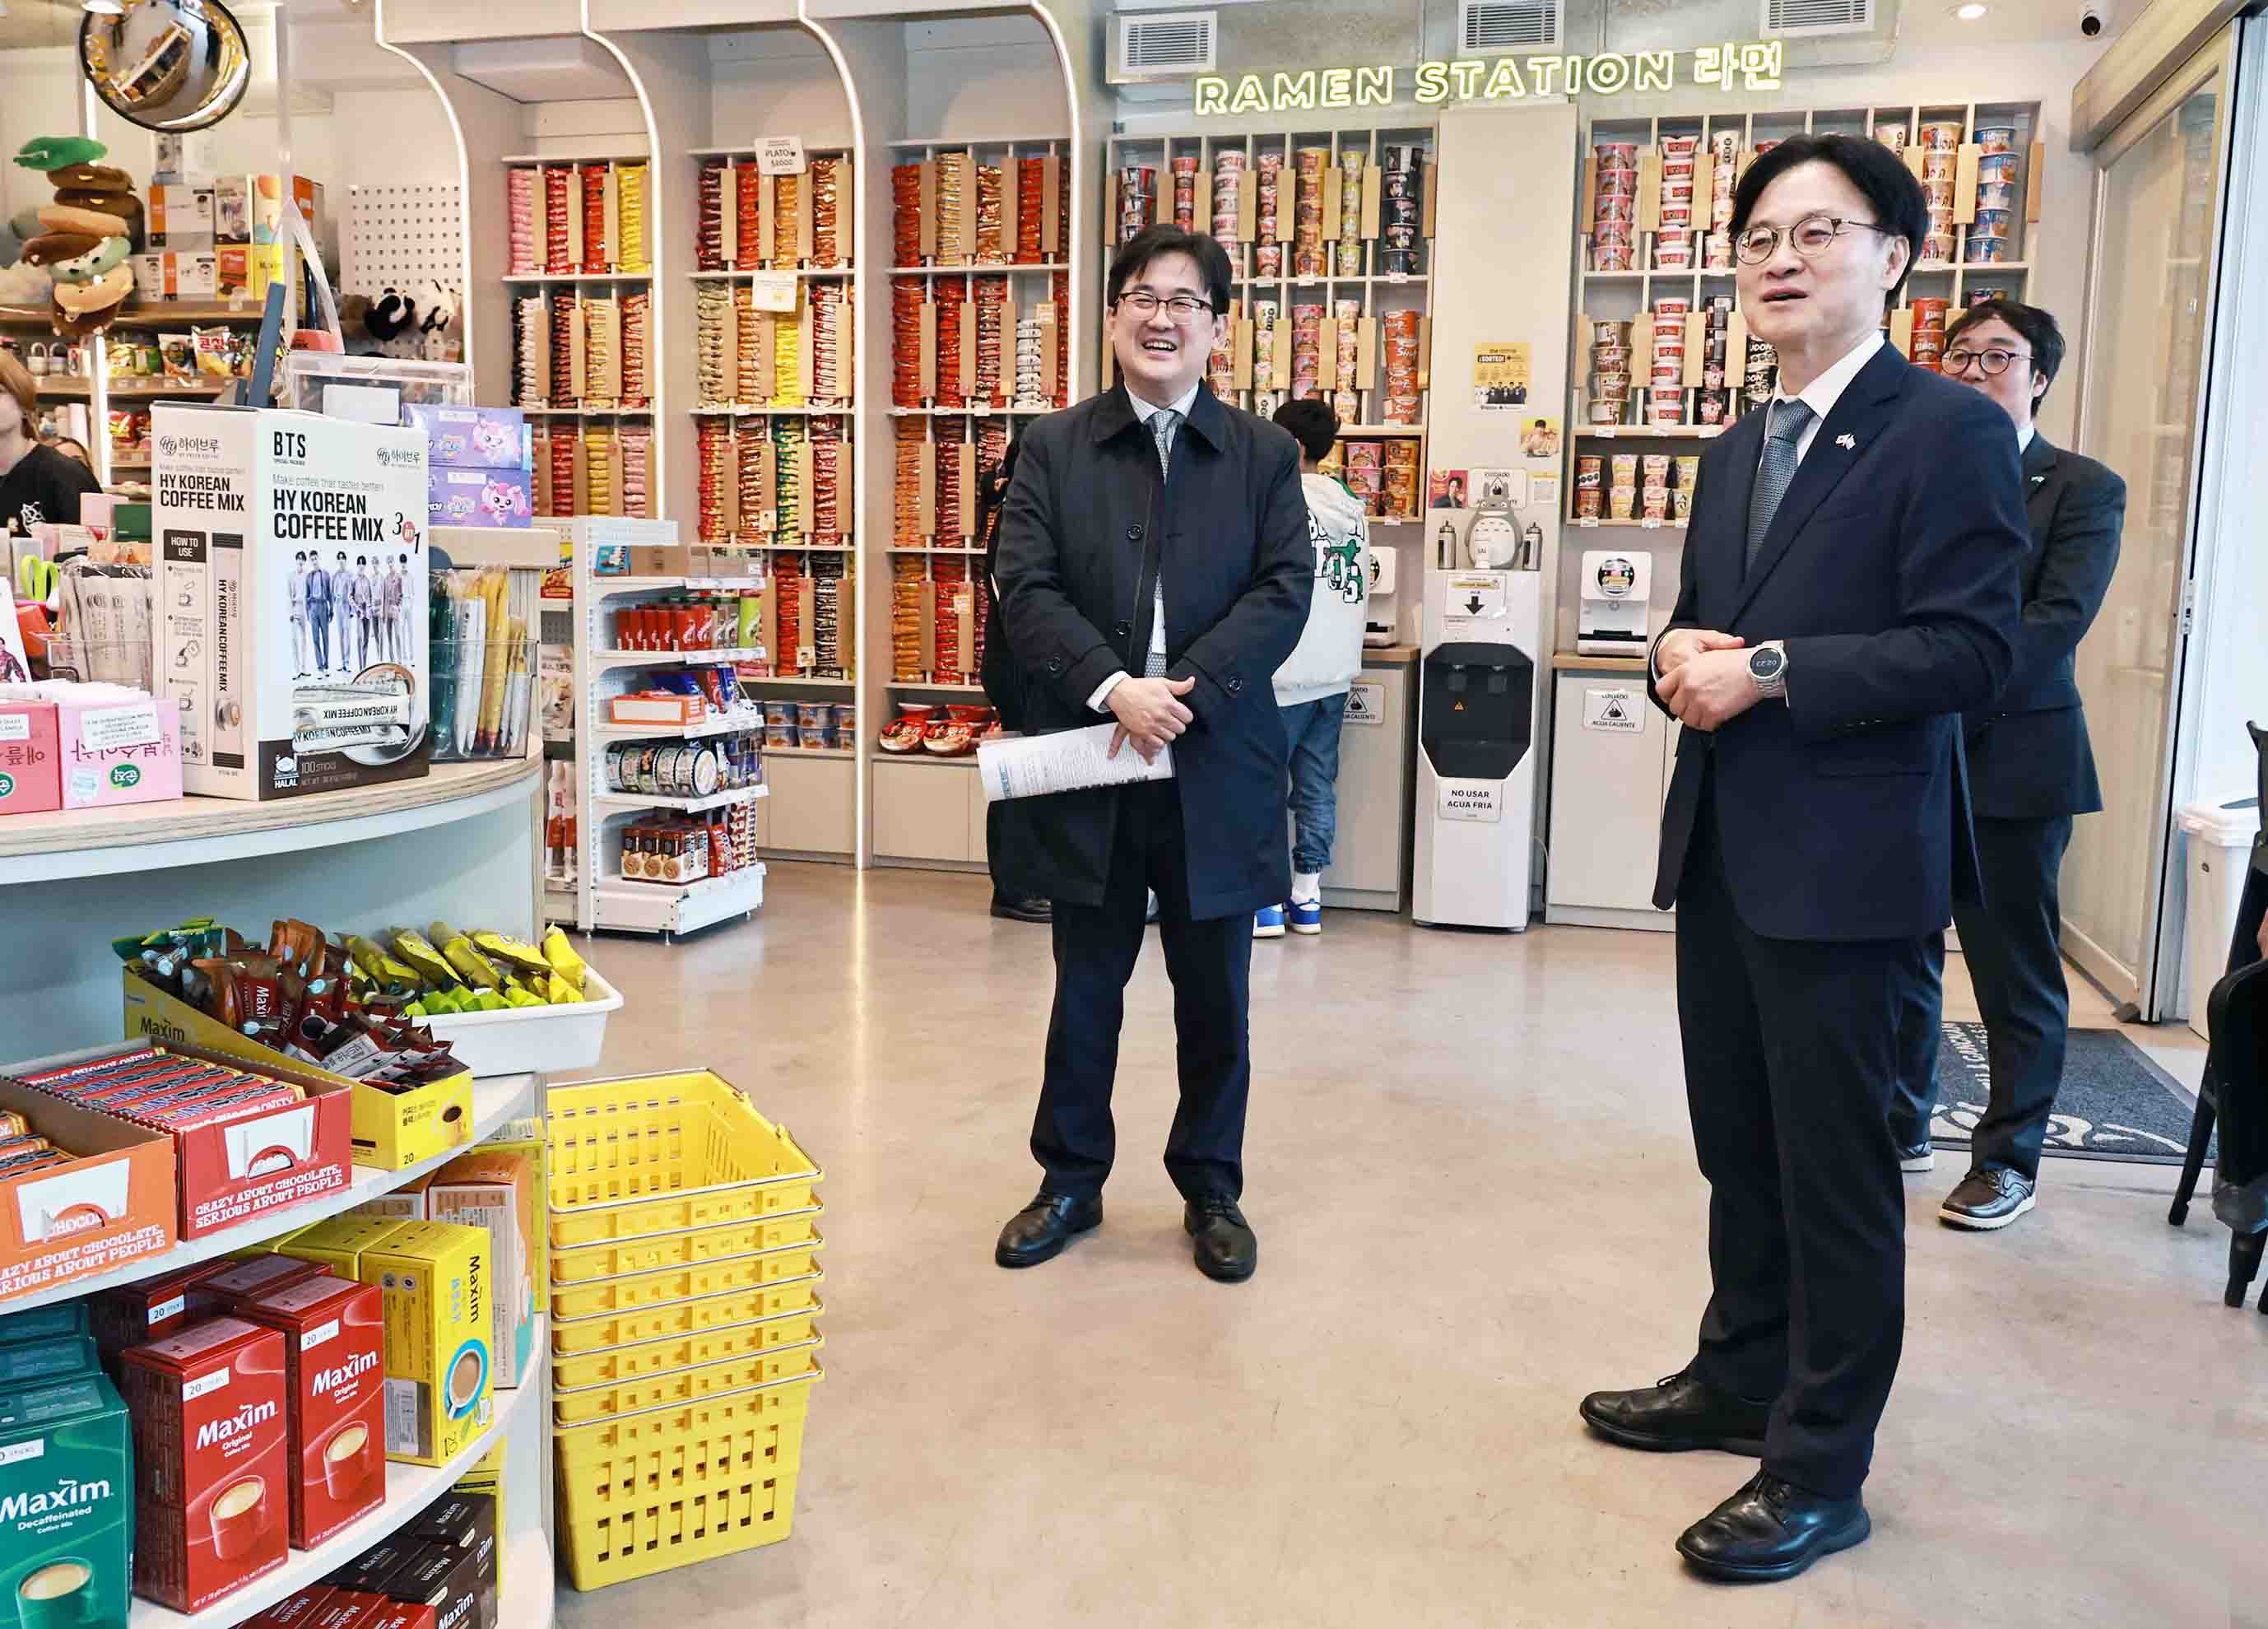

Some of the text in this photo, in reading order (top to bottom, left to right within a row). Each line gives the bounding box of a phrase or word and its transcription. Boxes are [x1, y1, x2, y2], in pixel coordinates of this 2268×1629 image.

[1694, 40, 1782, 91] 라면
[1194, 51, 1674, 115] RAMEN STATION
[179, 438, 218, 454] 하이브루
[273, 431, 306, 458] BTS
[391, 449, 421, 464] 하이브루
[160, 474, 230, 491] HY KOREAN
[160, 490, 244, 511] COFFEE MIX
[273, 488, 367, 514] HY KOREAN
[274, 512, 384, 542] COFFEE MIX
[171, 537, 198, 547] HOW TO
[179, 547, 193, 557] USE
[218, 579, 227, 593] HY
[0, 745, 45, 766] 애플
[301, 761, 316, 774] 100
[274, 779, 298, 789] HALAL
[255, 985, 272, 1018] Maxi
[140, 1017, 185, 1041] Maxim
[403, 1152, 415, 1164] 20
[195, 1163, 342, 1216] CRAZY ABOUT CHOCOLATE,
[195, 1174, 343, 1229] SERIOUS ABOUT PEOPLE
[32, 1246, 81, 1270] ABOUT
[82, 1224, 165, 1254] CHOCOLATE,
[0, 1235, 165, 1295] RIOUS ABOUT PEOPLE
[469, 1254, 483, 1324] Maxim
[153, 1307, 165, 1319] 20
[305, 1333, 316, 1345] 20
[312, 1350, 377, 1397] Maxim
[188, 1381, 202, 1395] 20
[334, 1380, 360, 1398] Original
[197, 1400, 276, 1450] Maxim
[222, 1431, 253, 1451] Original
[0, 1478, 110, 1523] Maxim
[17, 1506, 92, 1531] Decaffeinated
[436, 1502, 461, 1524] Maxim
[476, 1534, 494, 1562] xim
[421, 1557, 452, 1581] Maxim
[439, 1592, 475, 1629] Maxim
